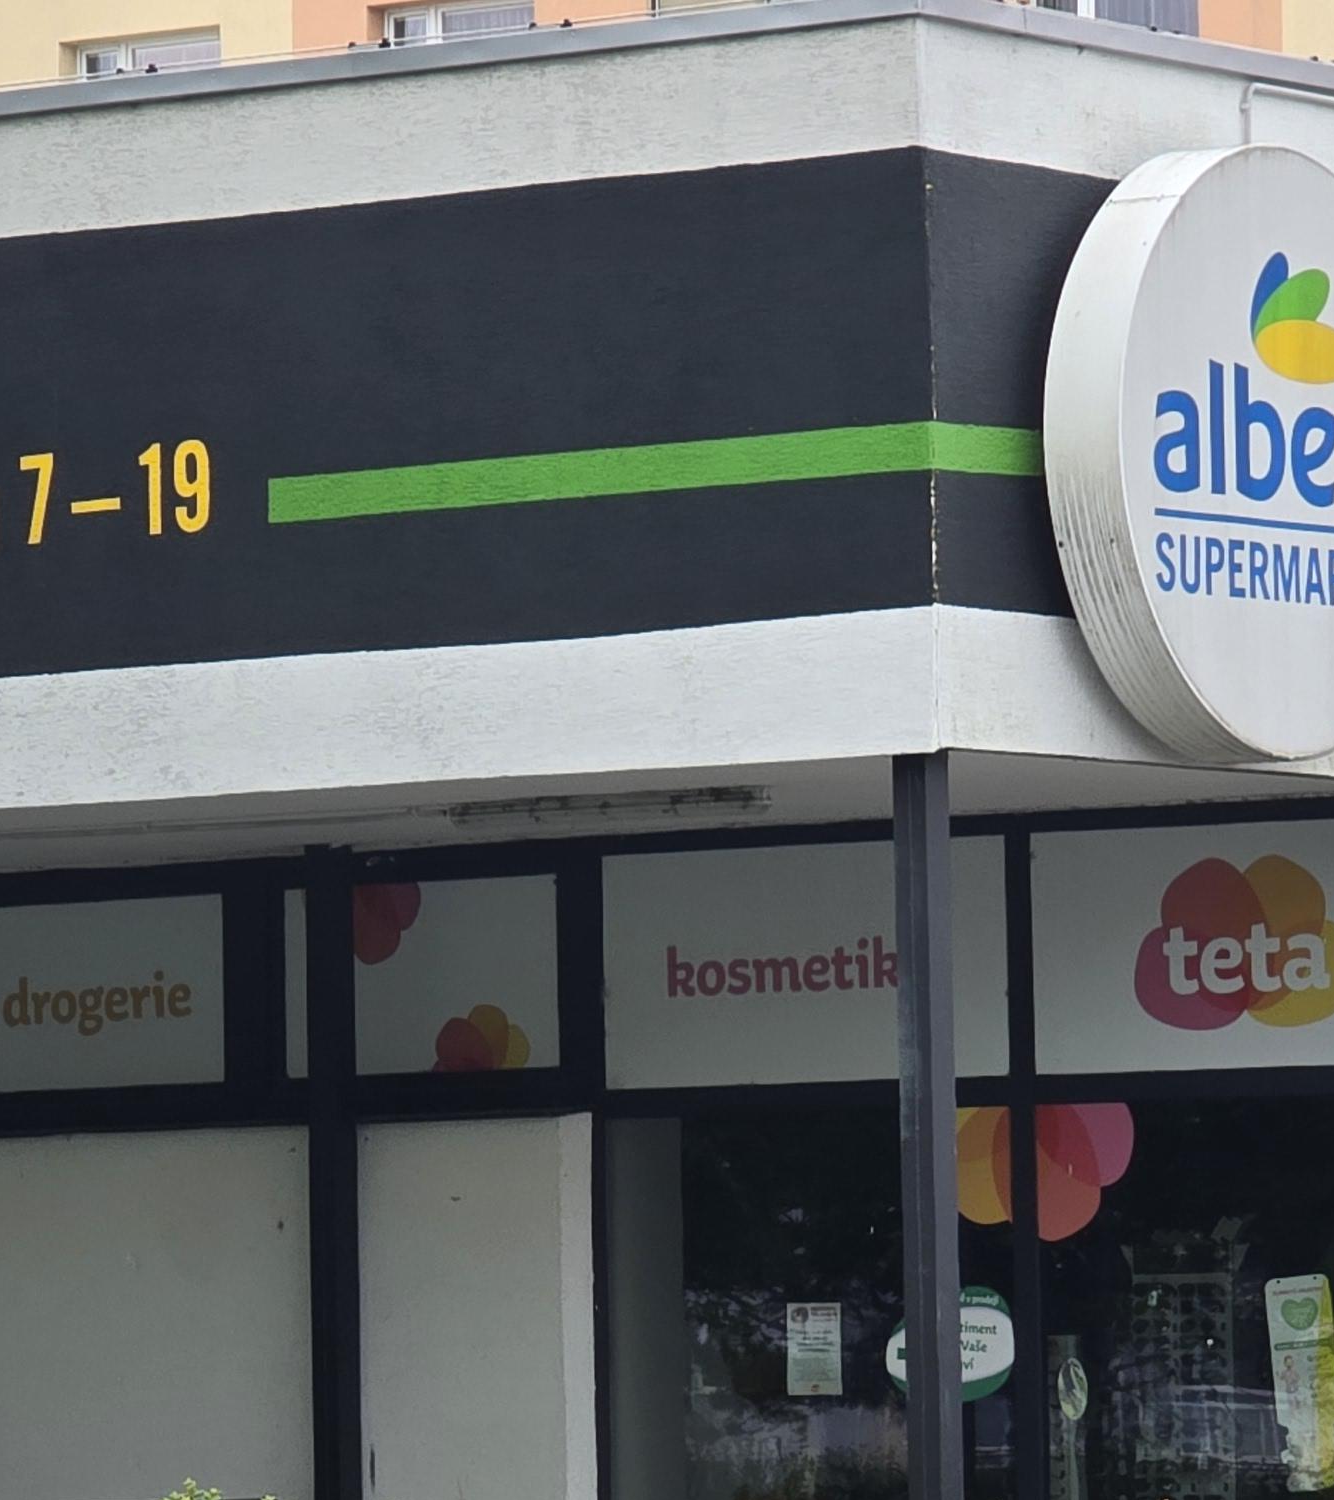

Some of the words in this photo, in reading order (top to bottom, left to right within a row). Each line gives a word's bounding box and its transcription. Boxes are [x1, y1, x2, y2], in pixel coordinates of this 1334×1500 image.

[19, 452, 54, 545] 7
[138, 439, 211, 535] 19
[1162, 922, 1331, 996] teta
[2, 970, 192, 1036] drogerie
